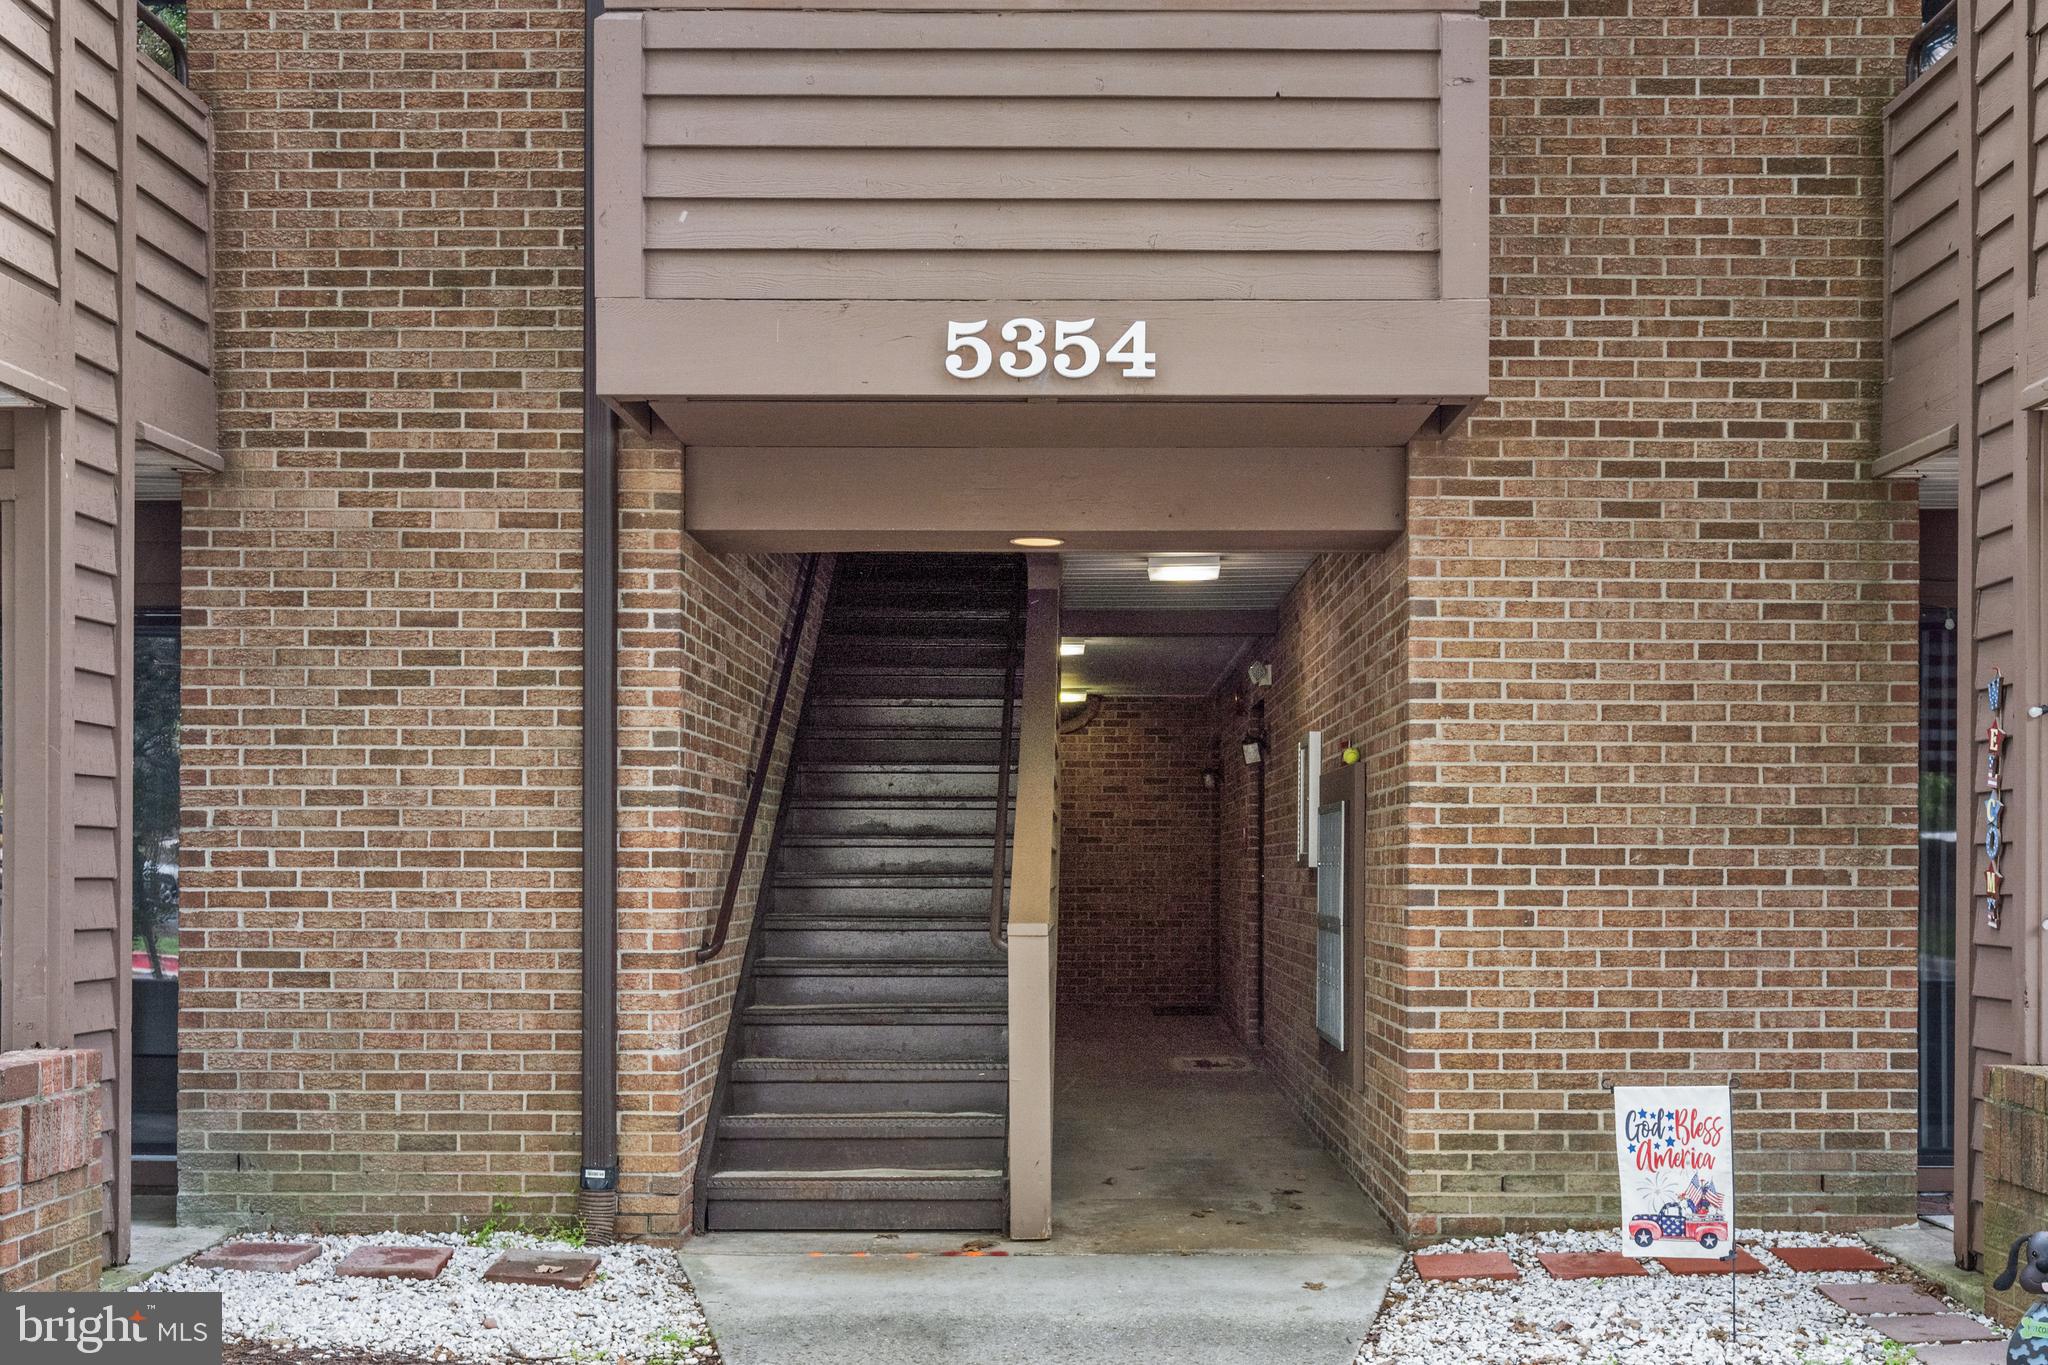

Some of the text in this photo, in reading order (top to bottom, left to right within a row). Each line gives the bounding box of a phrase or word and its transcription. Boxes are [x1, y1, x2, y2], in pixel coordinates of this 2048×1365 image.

[945, 318, 1156, 379] 5354
[1625, 1108, 1724, 1147] God Bless
[1636, 1139, 1716, 1173] America
